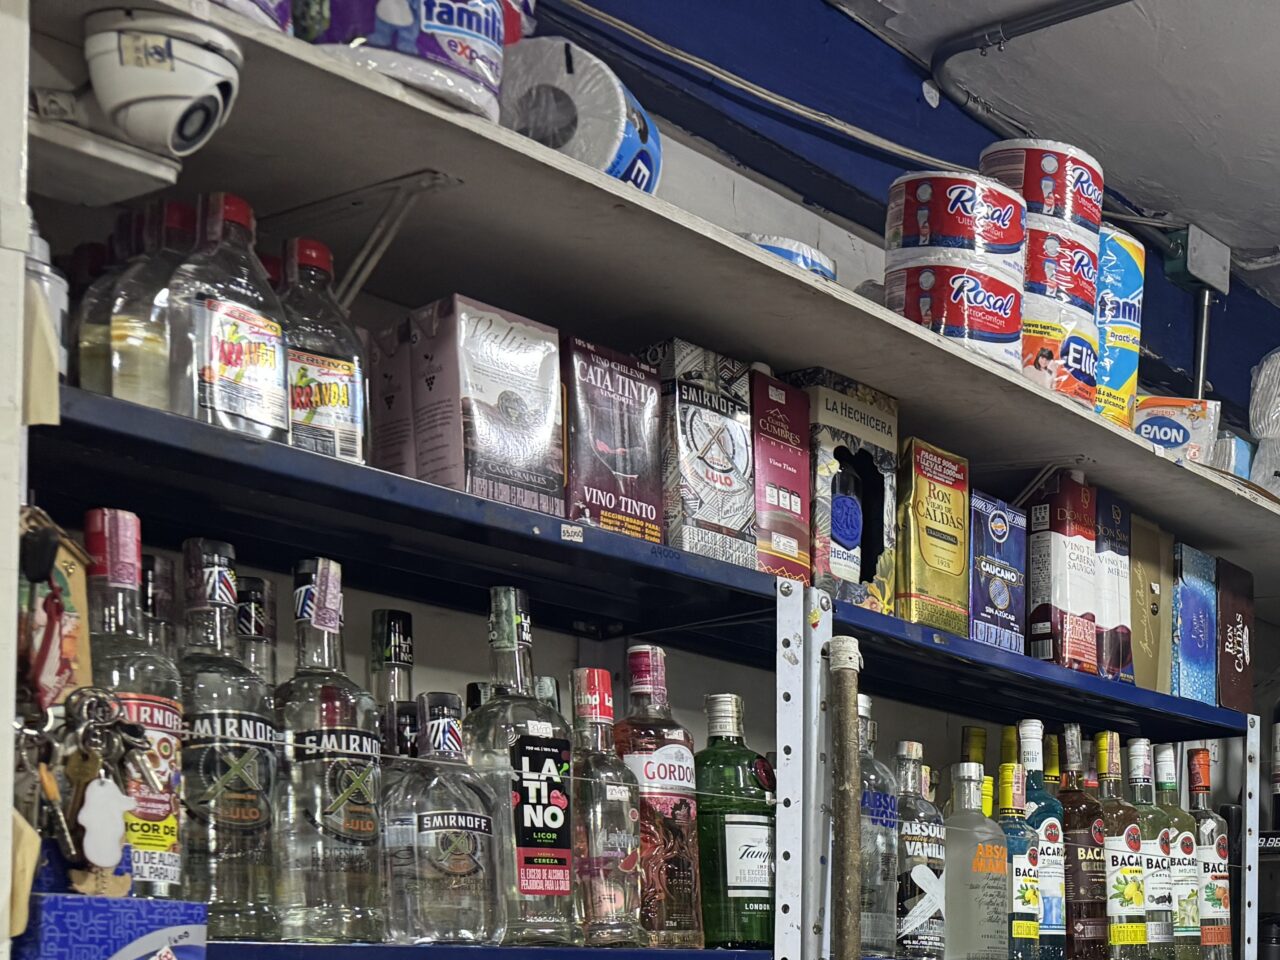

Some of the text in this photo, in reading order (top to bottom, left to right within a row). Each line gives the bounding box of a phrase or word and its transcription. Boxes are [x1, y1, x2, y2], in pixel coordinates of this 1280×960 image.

[947, 184, 1014, 229] Rosal
[950, 274, 1013, 318] Rosal
[577, 360, 658, 406] CATA TINTO
[825, 397, 893, 438] LA HECHICERA
[1141, 424, 1184, 444] Nova
[704, 469, 733, 488] LULO
[584, 486, 616, 509] VINO
[619, 496, 656, 521] TINTO
[927, 481, 952, 505] RON
[916, 501, 964, 531] CALDAS
[980, 559, 1017, 583] CAUCANO
[1235, 612, 1245, 673] CALDAS
[521, 756, 562, 784] LA
[523, 778, 549, 804] TI
[523, 804, 566, 829] NO
[163, 824, 176, 836] DE
[533, 832, 557, 841] LICOR
[533, 857, 559, 865] CEREZA
